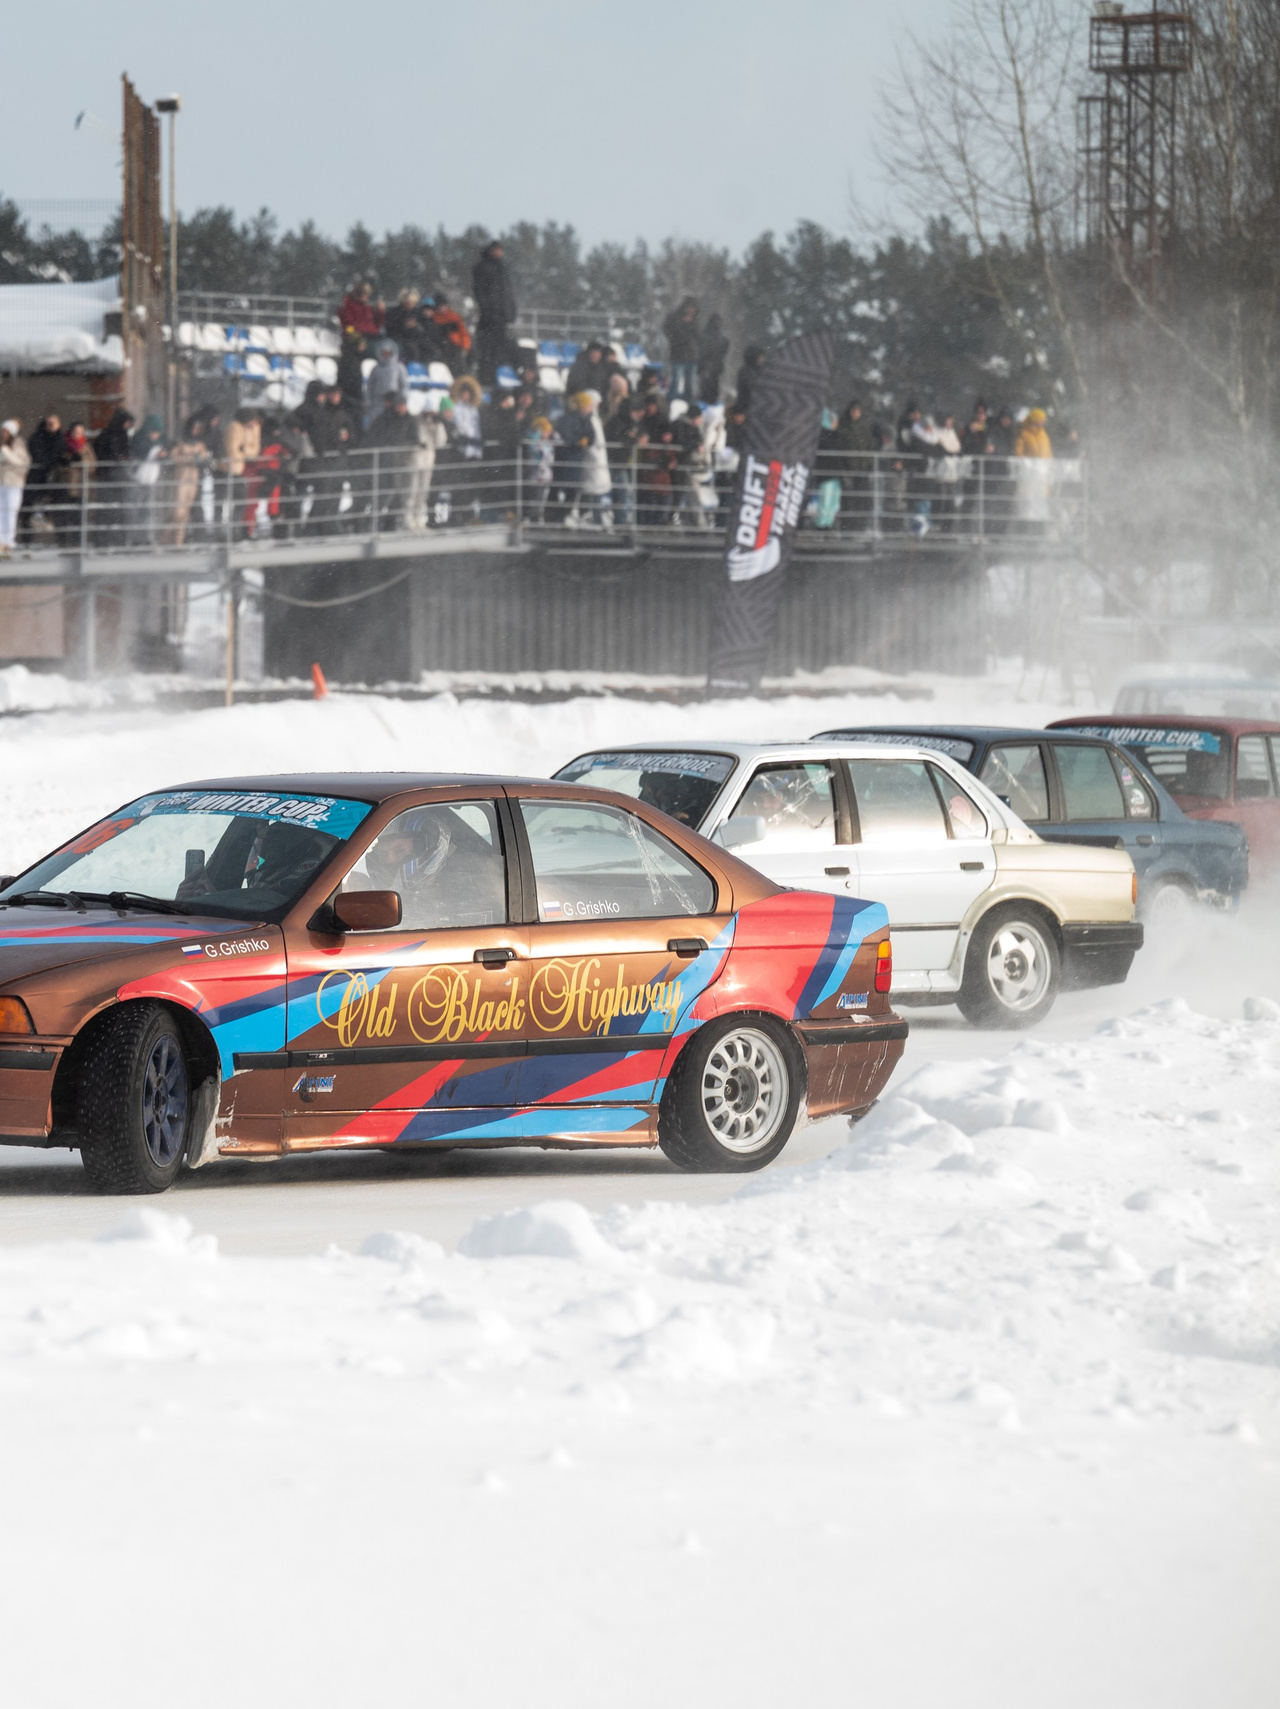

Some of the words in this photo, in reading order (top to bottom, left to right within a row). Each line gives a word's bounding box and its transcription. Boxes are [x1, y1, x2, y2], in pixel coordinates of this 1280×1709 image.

[736, 454, 770, 547] DRIFT
[770, 464, 796, 536] TRACK
[1108, 727, 1167, 742] WINTER
[186, 794, 281, 814] WINTER
[268, 799, 330, 820] CUP
[563, 900, 620, 916] G.Grishko
[204, 938, 270, 958] G.Grishko
[317, 969, 398, 1047] Old
[408, 965, 526, 1043] Black
[529, 958, 684, 1036] Highway
